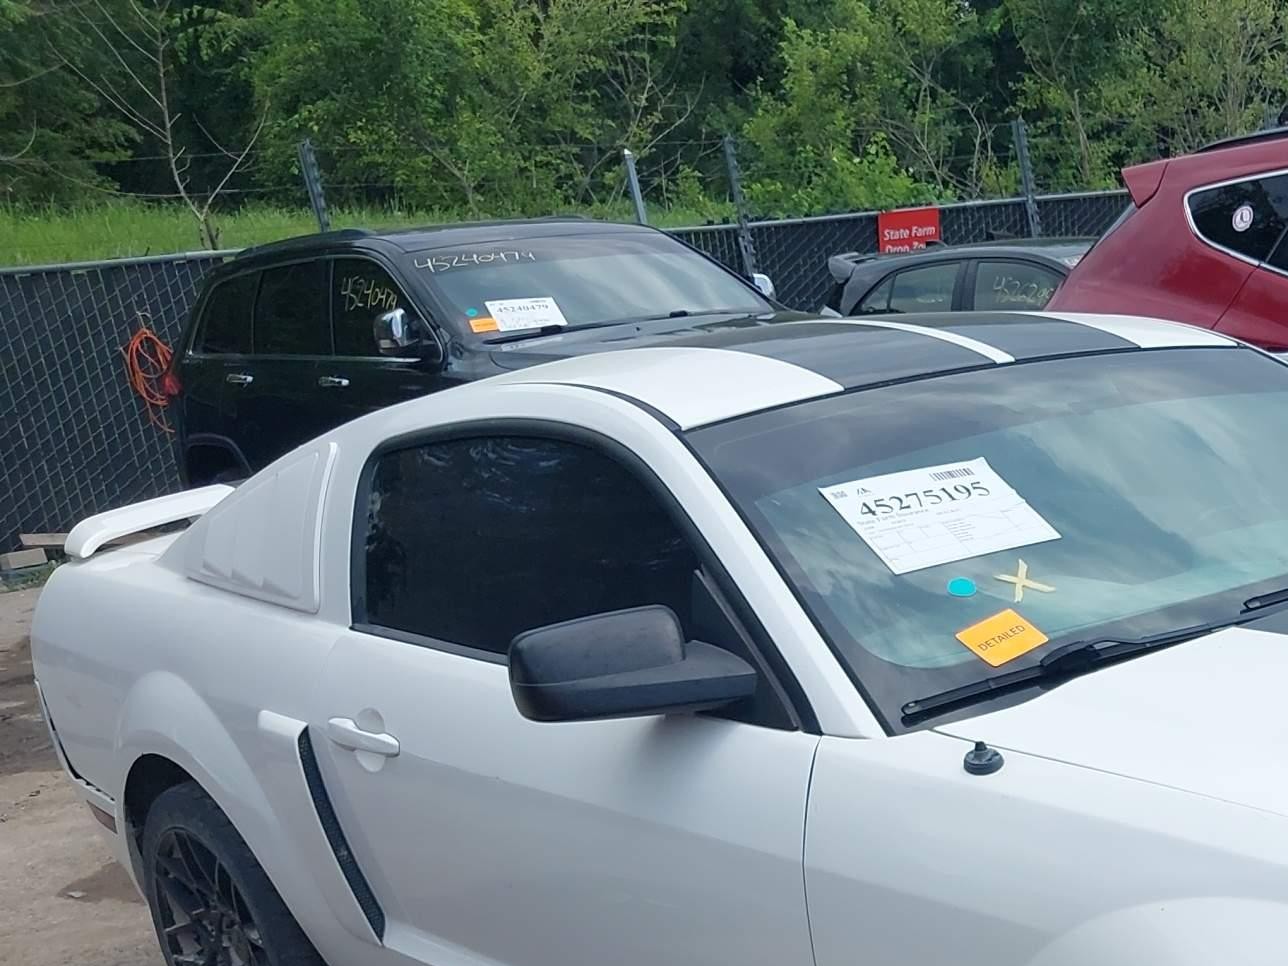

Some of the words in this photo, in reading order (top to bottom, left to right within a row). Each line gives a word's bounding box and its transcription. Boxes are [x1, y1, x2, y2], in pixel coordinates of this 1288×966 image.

[884, 228, 910, 241] State
[911, 225, 936, 237] Farm
[860, 481, 990, 516] 45275195
[977, 624, 1026, 651] DETAILED
